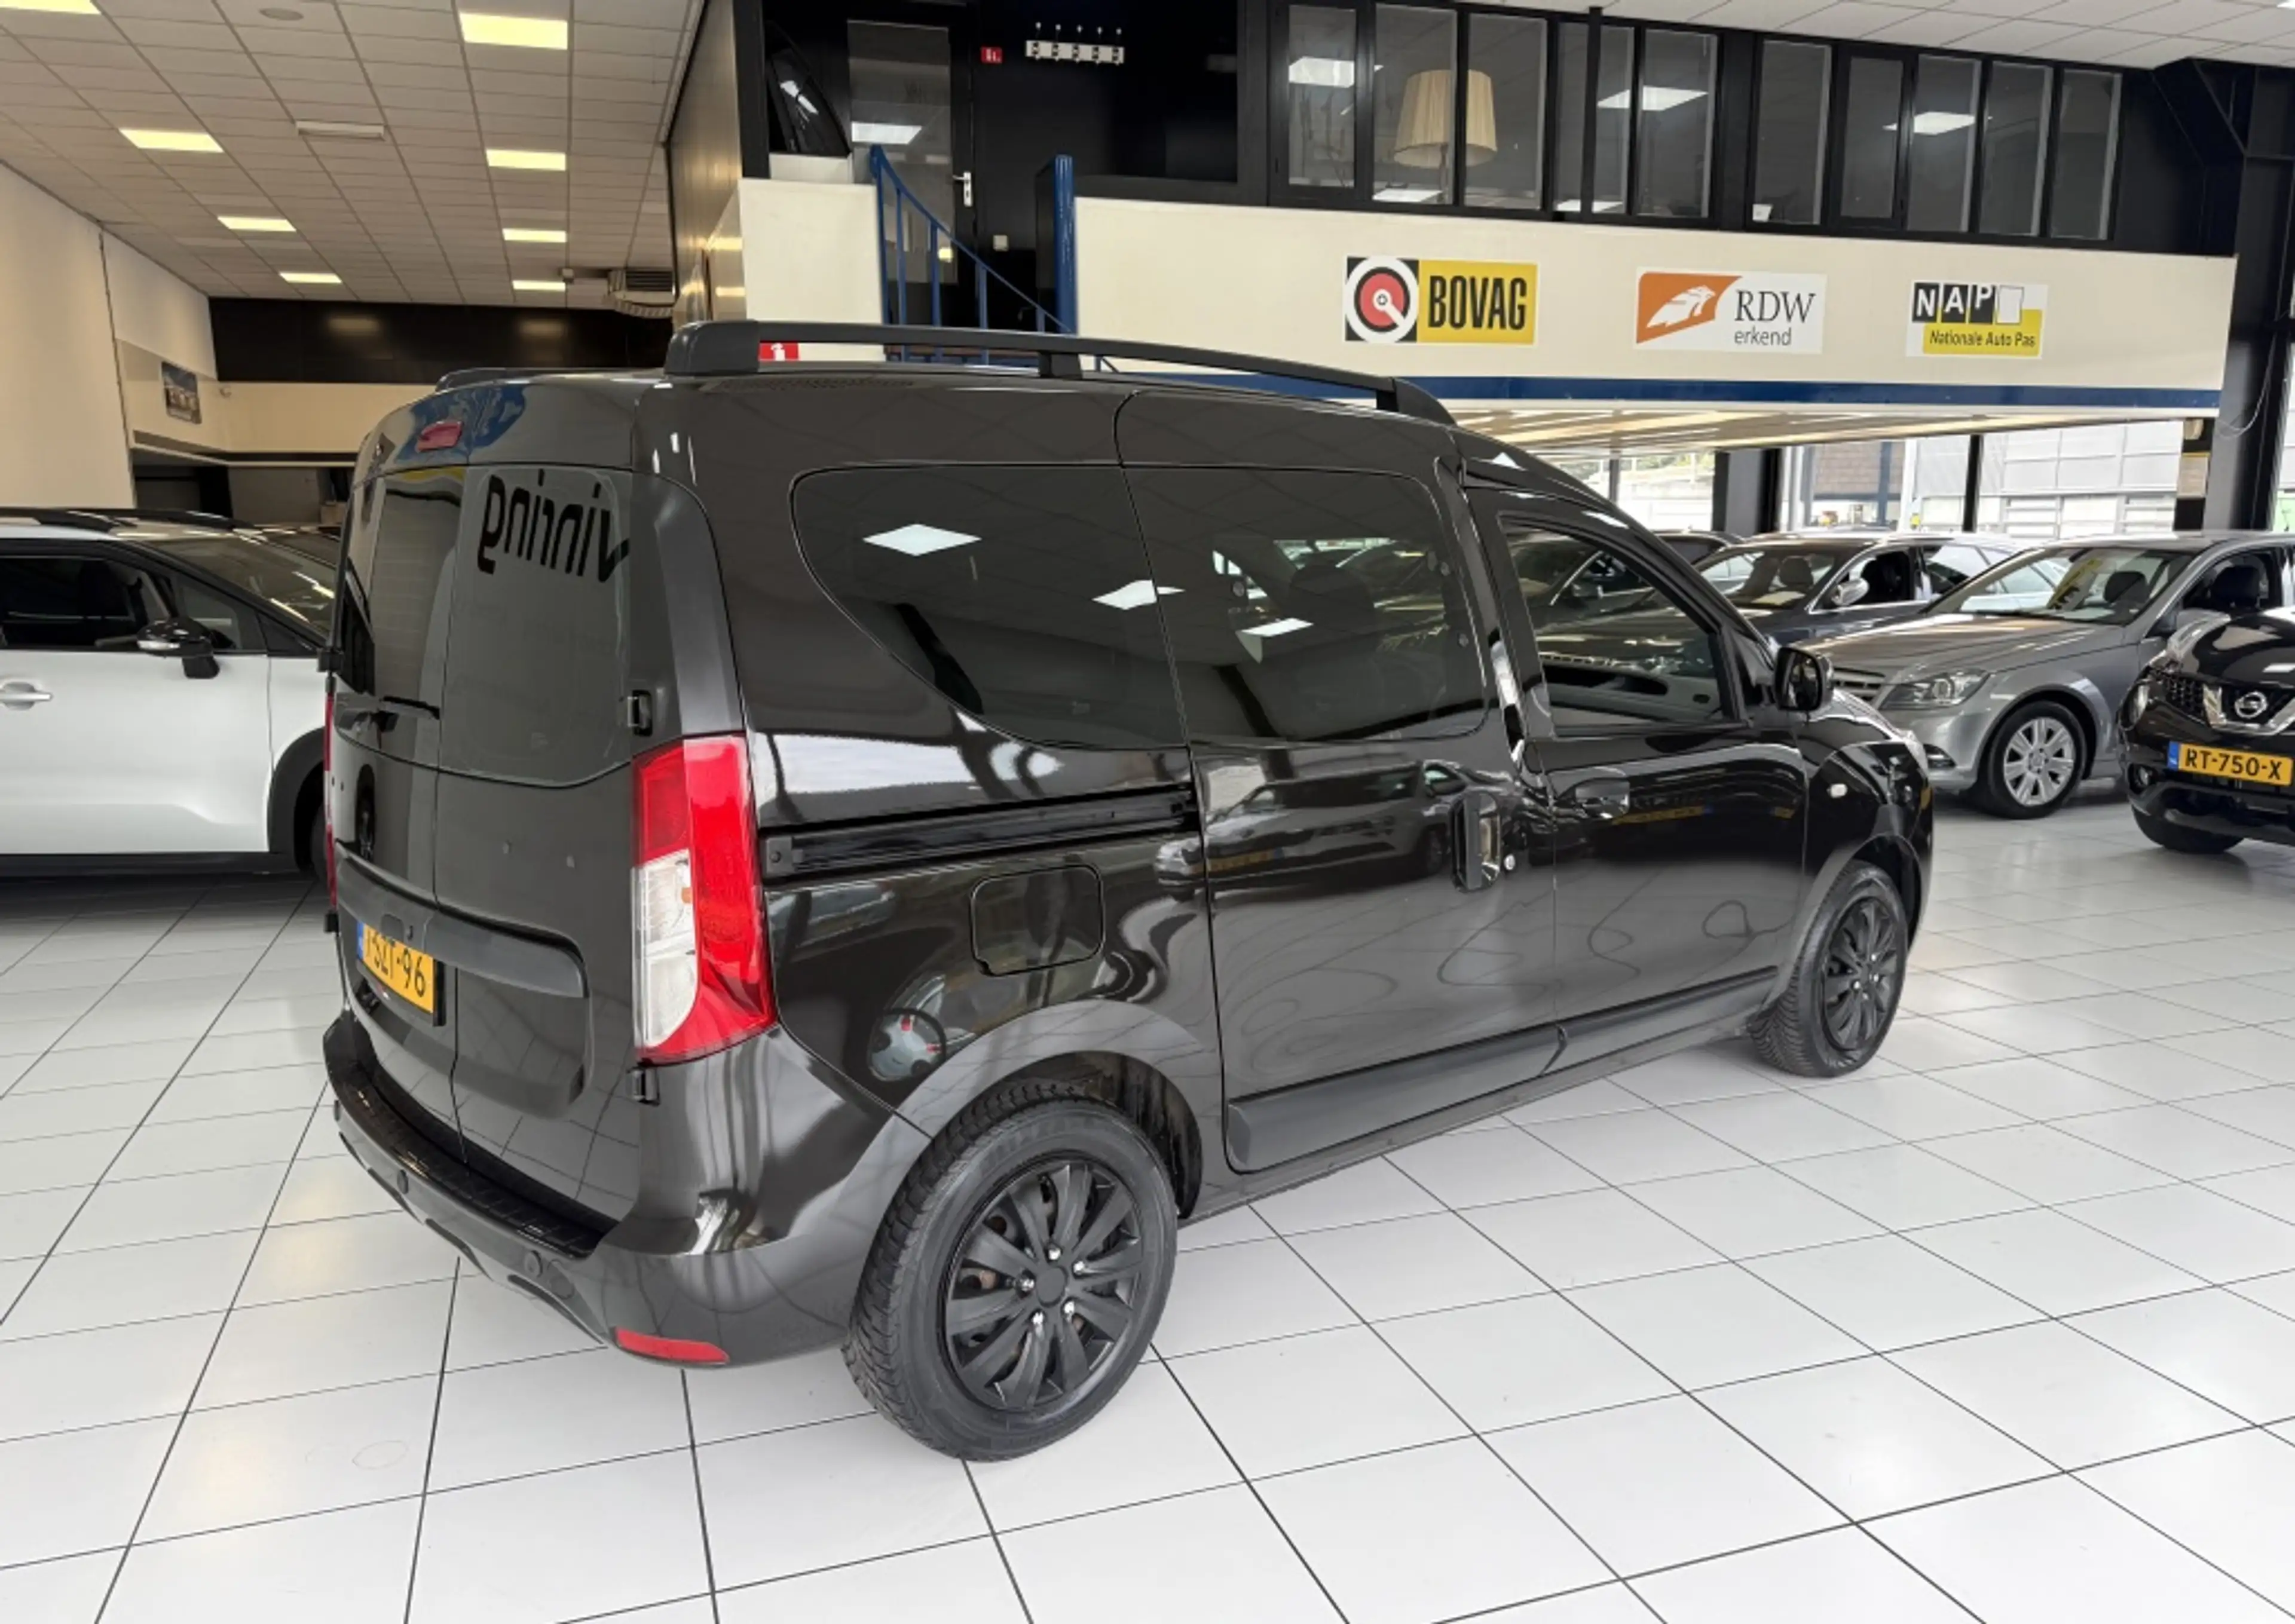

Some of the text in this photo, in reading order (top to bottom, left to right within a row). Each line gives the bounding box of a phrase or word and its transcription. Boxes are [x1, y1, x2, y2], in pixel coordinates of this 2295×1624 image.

[1428, 274, 1528, 330] BOVAG
[1734, 289, 1816, 323] RDW
[1916, 284, 1993, 317] NAP
[1734, 326, 1792, 346] erkend
[1929, 329, 2036, 348] Nationale Auto Pas
[2184, 747, 2282, 780] RT-750-X
